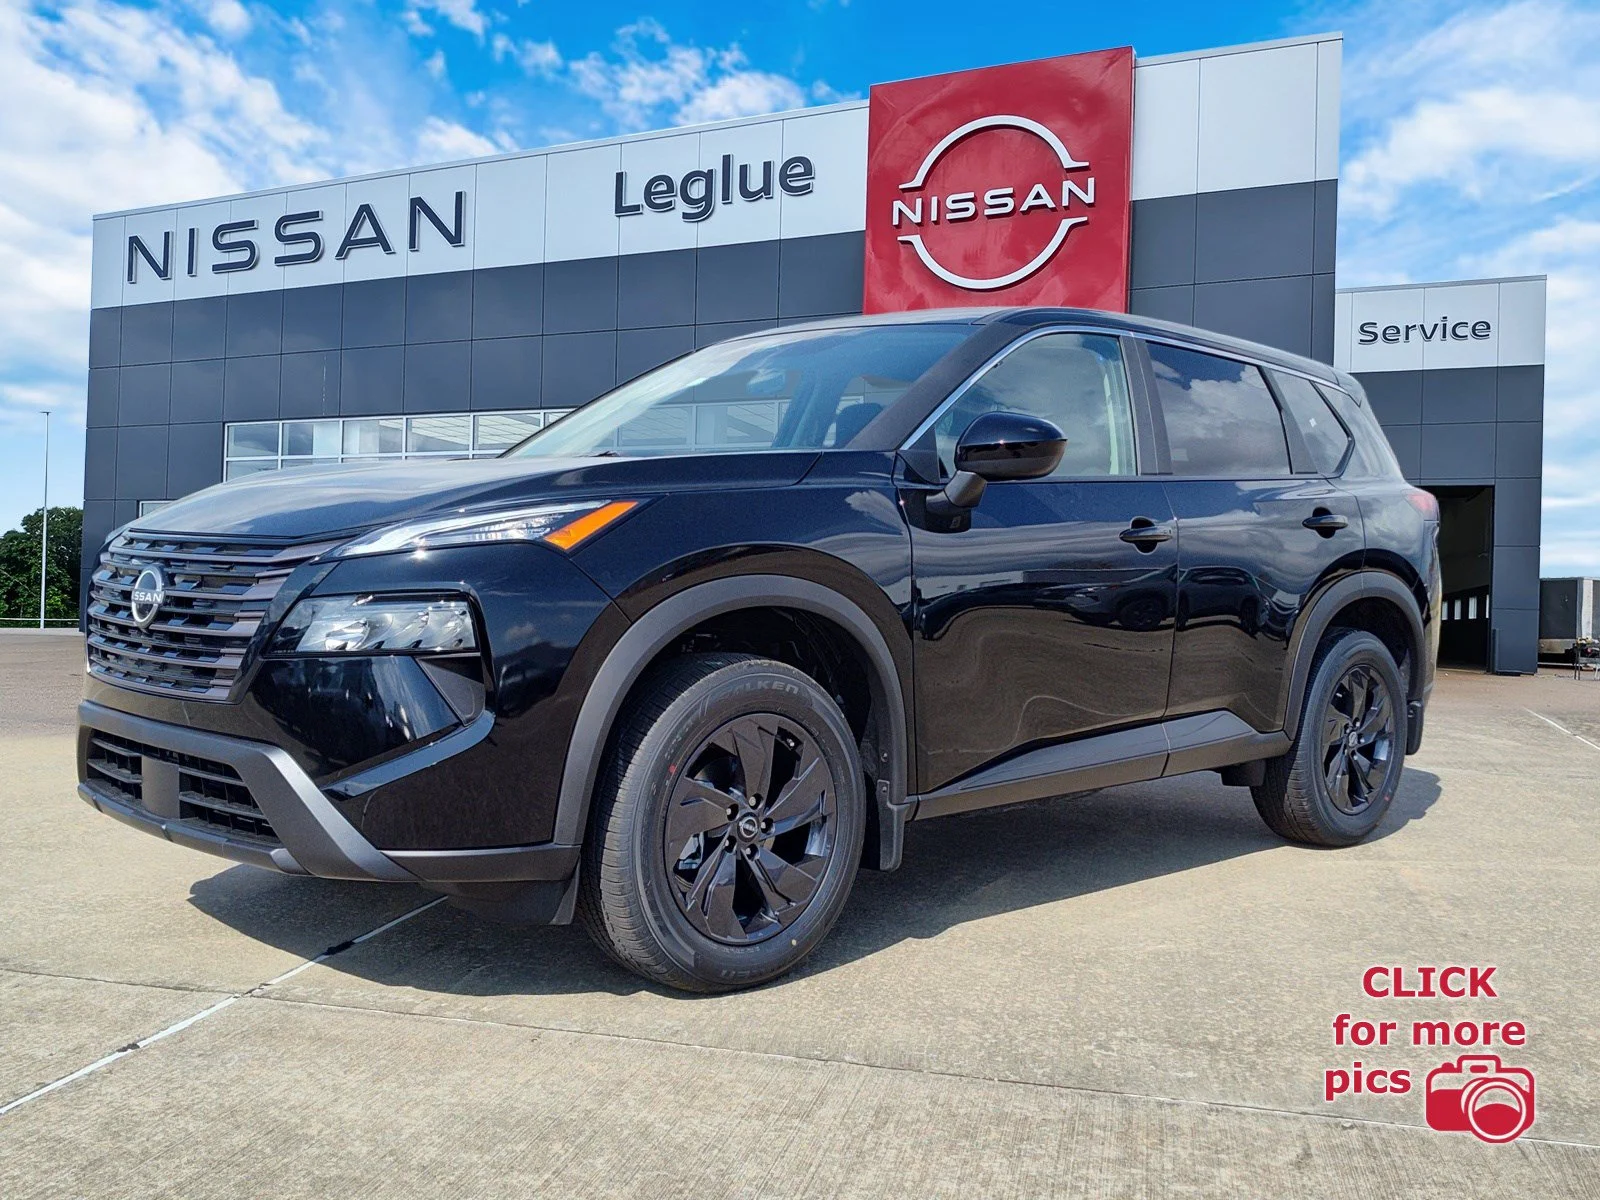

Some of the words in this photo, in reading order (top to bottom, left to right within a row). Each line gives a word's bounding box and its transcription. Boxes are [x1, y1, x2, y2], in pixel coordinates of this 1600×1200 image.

[615, 154, 816, 222] Leglue
[892, 177, 1096, 227] NISSAN
[128, 190, 465, 284] NISSAN
[1359, 316, 1491, 345] Service
[132, 590, 163, 603] SSAN
